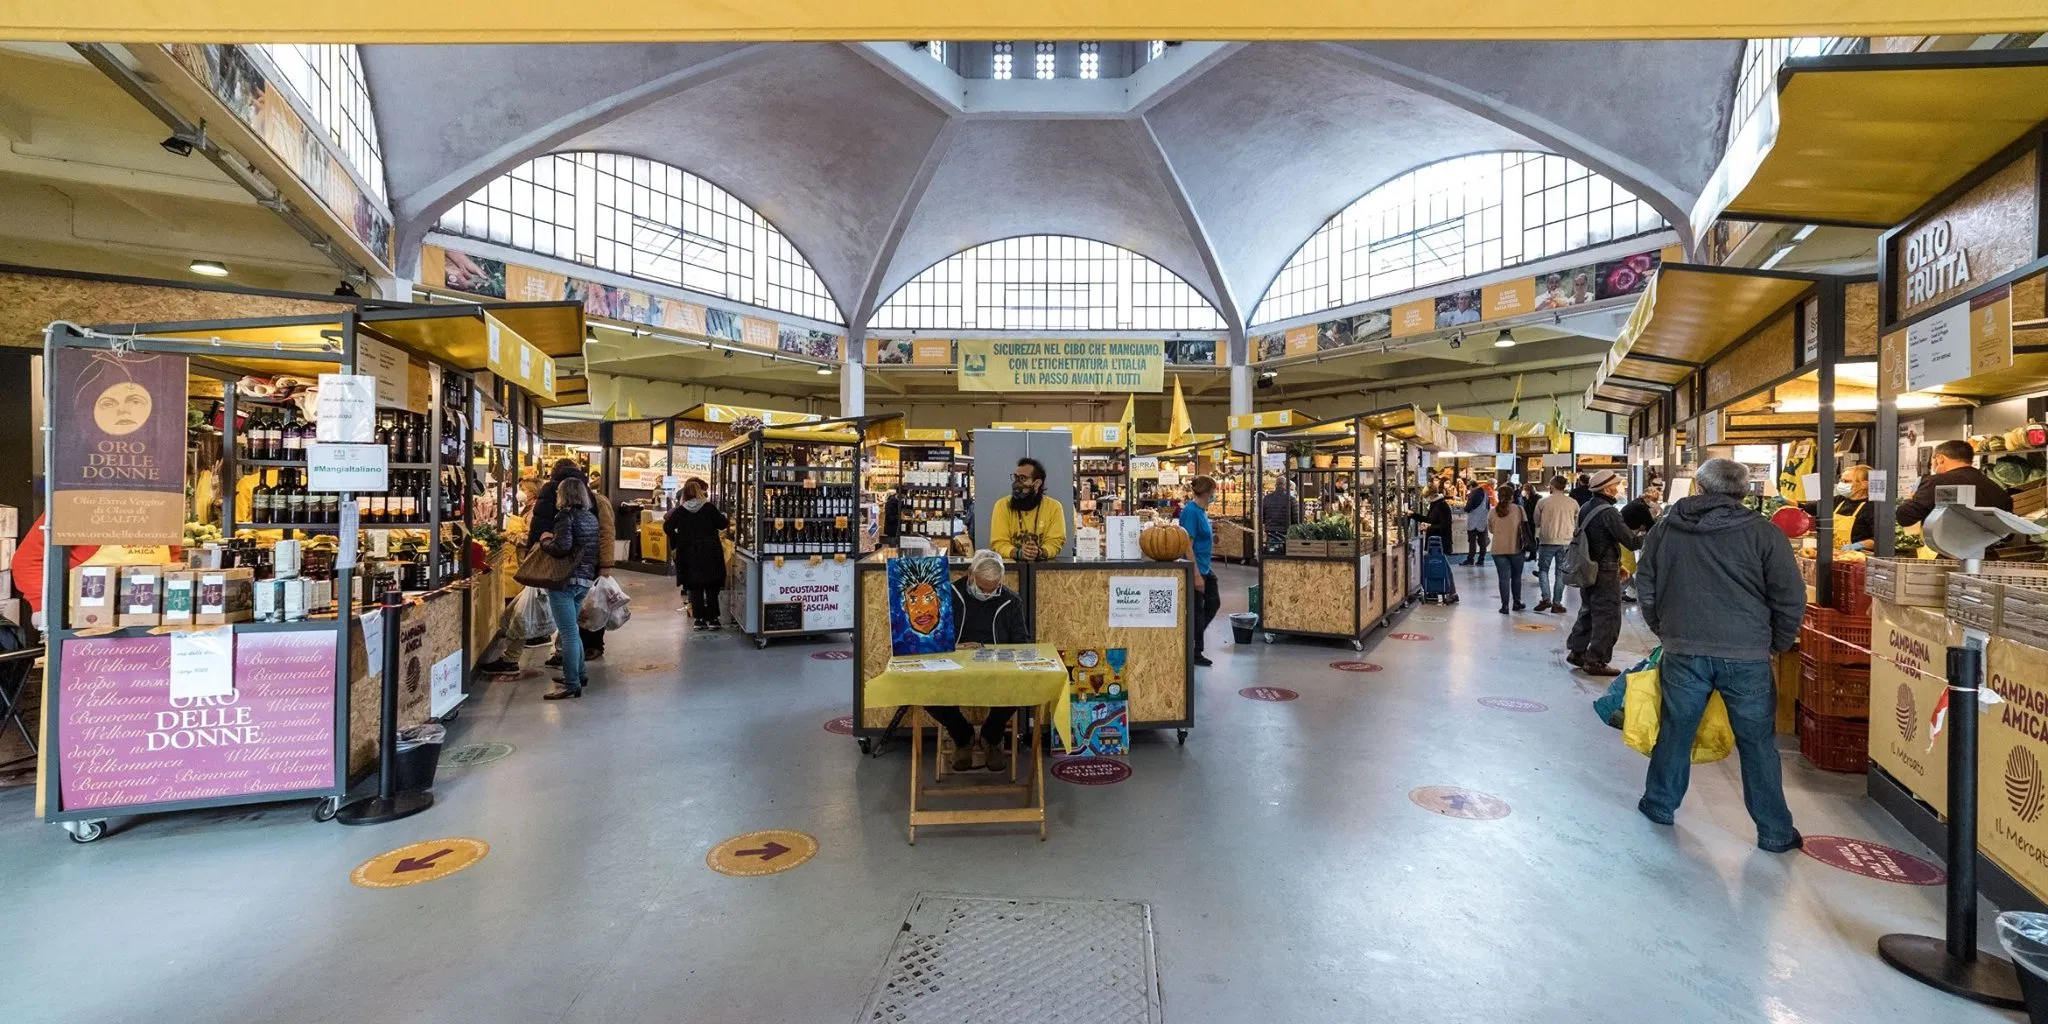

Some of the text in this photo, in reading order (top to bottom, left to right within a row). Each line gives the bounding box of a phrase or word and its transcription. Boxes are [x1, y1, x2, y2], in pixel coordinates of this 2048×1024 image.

[1907, 247, 1969, 309] FRUTTA
[993, 343, 1041, 355] SICUREZZA
[1044, 343, 1061, 355] NEL
[1064, 343, 1085, 355] CIBO
[1089, 343, 1107, 355] CHE
[1008, 358, 1147, 370] CON L'ETICHETTATURA L'ITALIA
[1014, 370, 1141, 385] È UN PASSO AVANTI A TUTTI
[680, 428, 724, 440] FORMAGGI
[97, 440, 146, 454] ORO
[88, 453, 154, 467] DELLE
[1131, 461, 1156, 469] BIRRA
[82, 465, 160, 480] DONNE
[314, 465, 382, 474] #MangiaItaliano
[72, 495, 167, 508] Olio Extra Vergine
[93, 506, 146, 515] di Oliva di
[57, 529, 180, 539] www.orodelledonne.it
[779, 584, 840, 595] DEGUSTAZIONE
[1115, 586, 1141, 597] Ordina
[790, 594, 829, 603] GRATUITA
[400, 622, 426, 643] CAMPAGNA
[72, 641, 162, 657] Benvenuti
[404, 636, 422, 654] AMICA
[1889, 629, 1931, 665] CAMPAGNA
[244, 648, 322, 666] Bem-vindo
[83, 657, 148, 673] Welkom
[247, 663, 331, 682] Bienvenida
[154, 706, 252, 731] DELLE
[81, 724, 147, 741] Welkom
[145, 726, 261, 751] DONNE
[223, 746, 328, 762] Willkommen
[266, 760, 330, 775] Welcome
[71, 774, 160, 792] Benvenuti
[85, 789, 148, 806] Welkom
[243, 773, 322, 793] Bem-vindo
